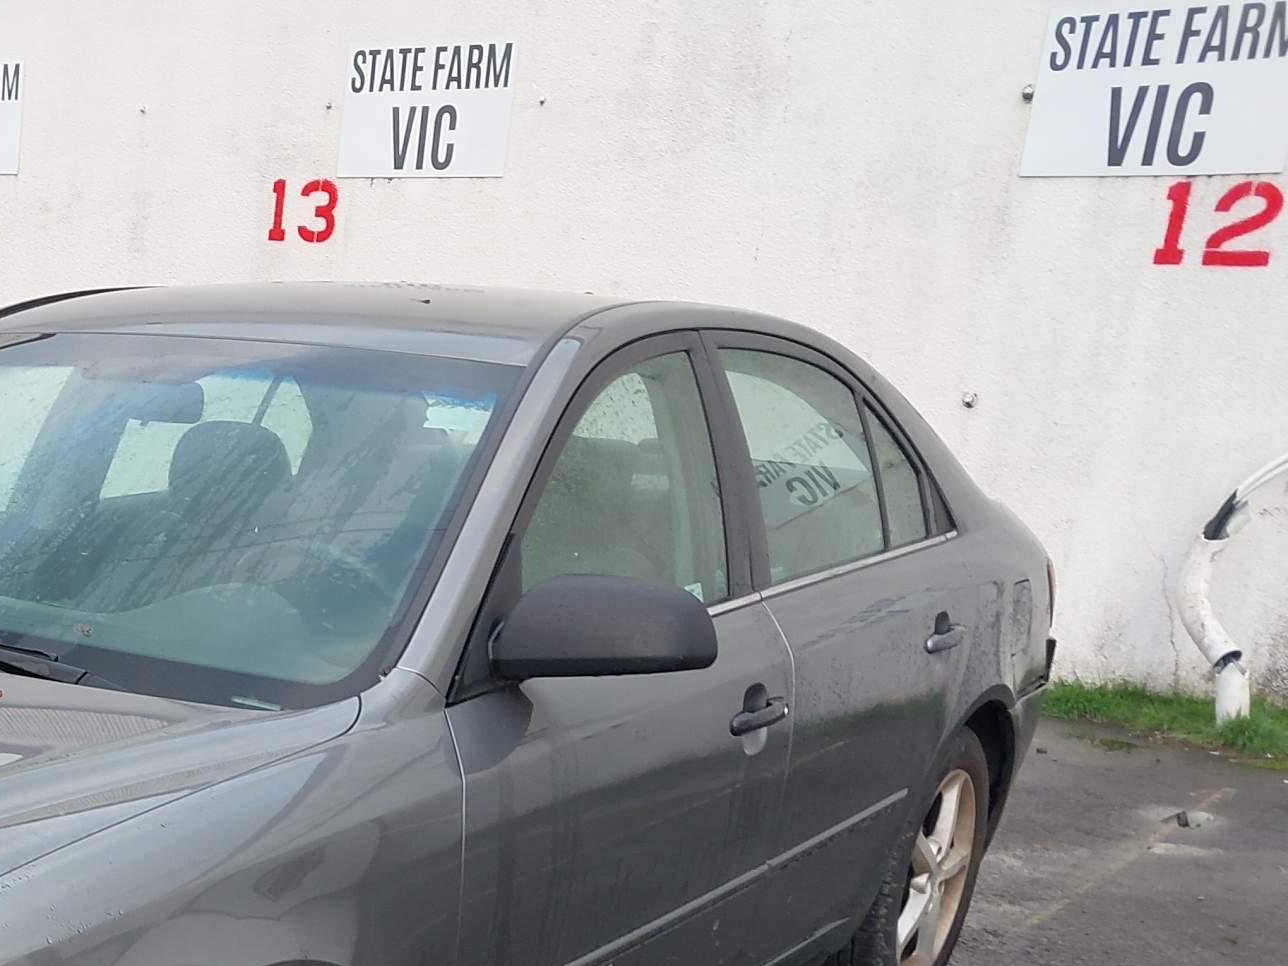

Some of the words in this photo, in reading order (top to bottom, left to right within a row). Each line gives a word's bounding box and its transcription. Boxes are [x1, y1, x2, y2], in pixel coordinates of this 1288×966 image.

[350, 47, 427, 94] STATE
[431, 42, 514, 91] FARM
[1049, 8, 1172, 72] STATE
[392, 104, 457, 171] VIC
[1106, 81, 1214, 167] VIC
[268, 178, 338, 243] 13
[1152, 181, 1285, 267] 12
